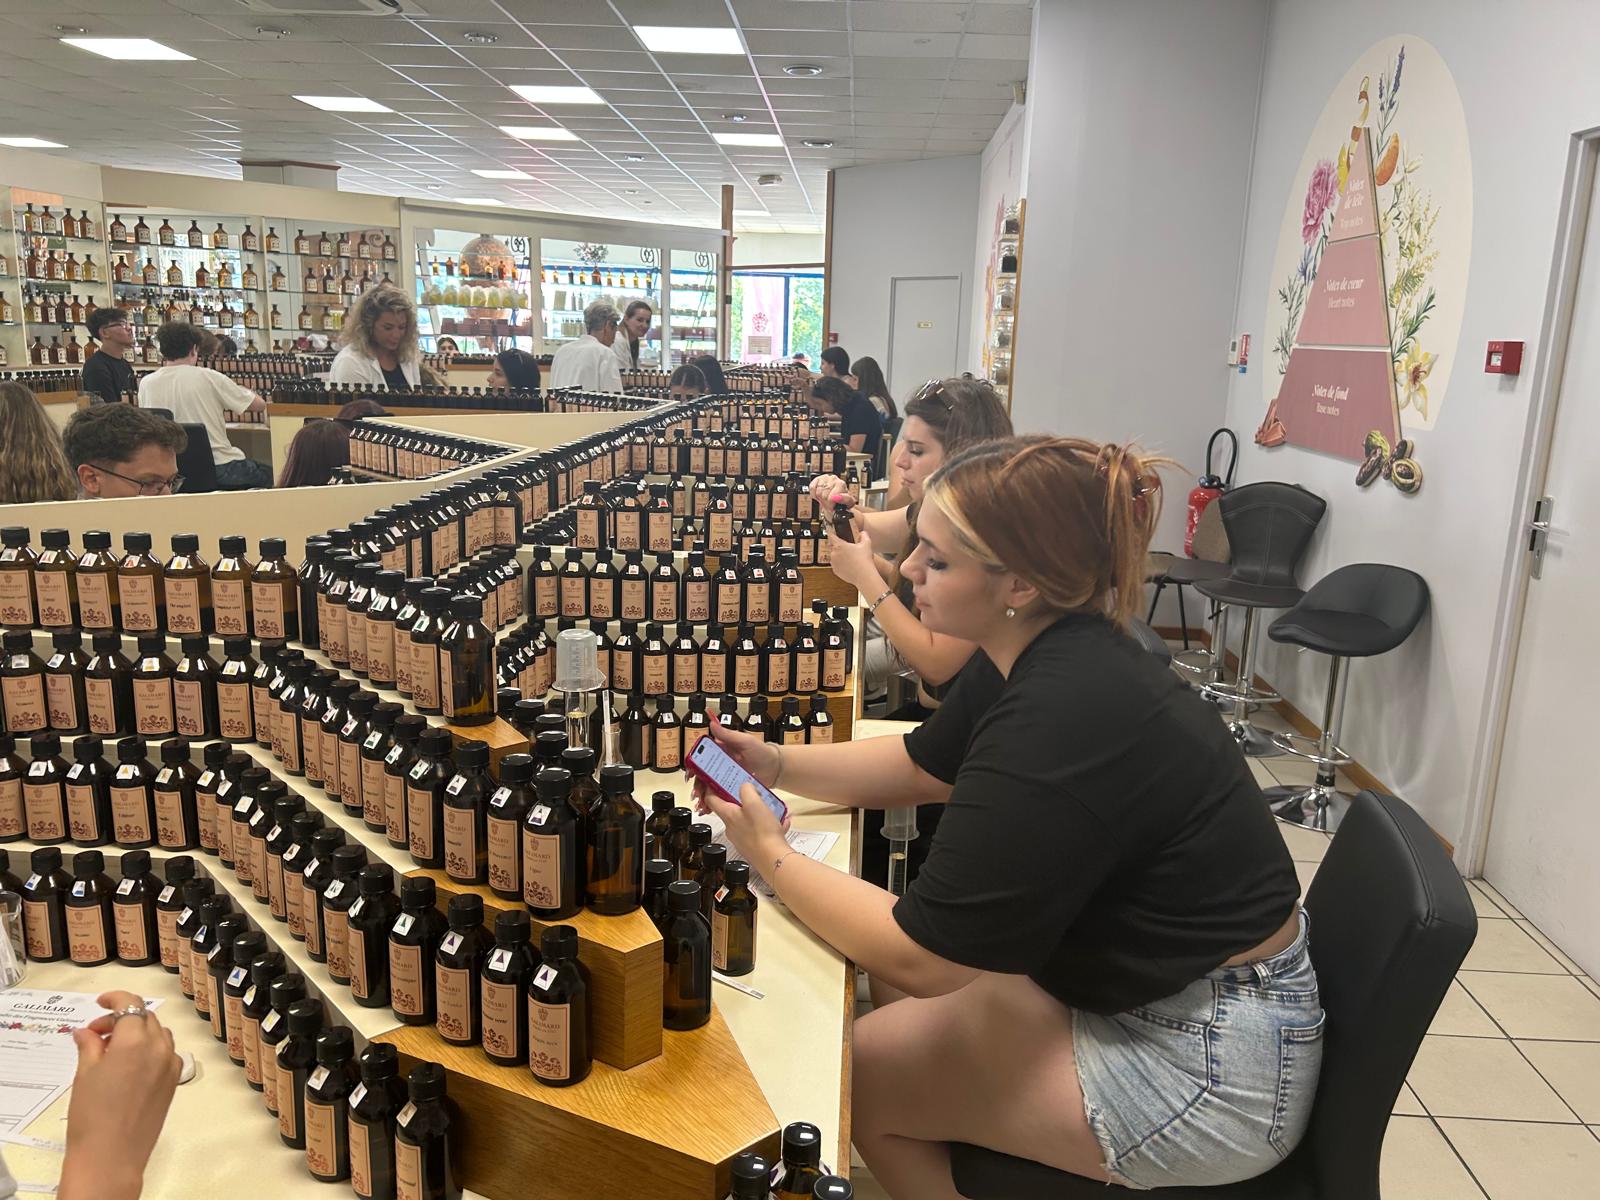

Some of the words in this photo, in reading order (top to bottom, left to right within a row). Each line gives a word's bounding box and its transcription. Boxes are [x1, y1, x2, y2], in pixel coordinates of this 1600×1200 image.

[1311, 384, 1327, 398] Notes
[1334, 386, 1350, 401] fond
[13, 1003, 76, 1013] GALIMARD
